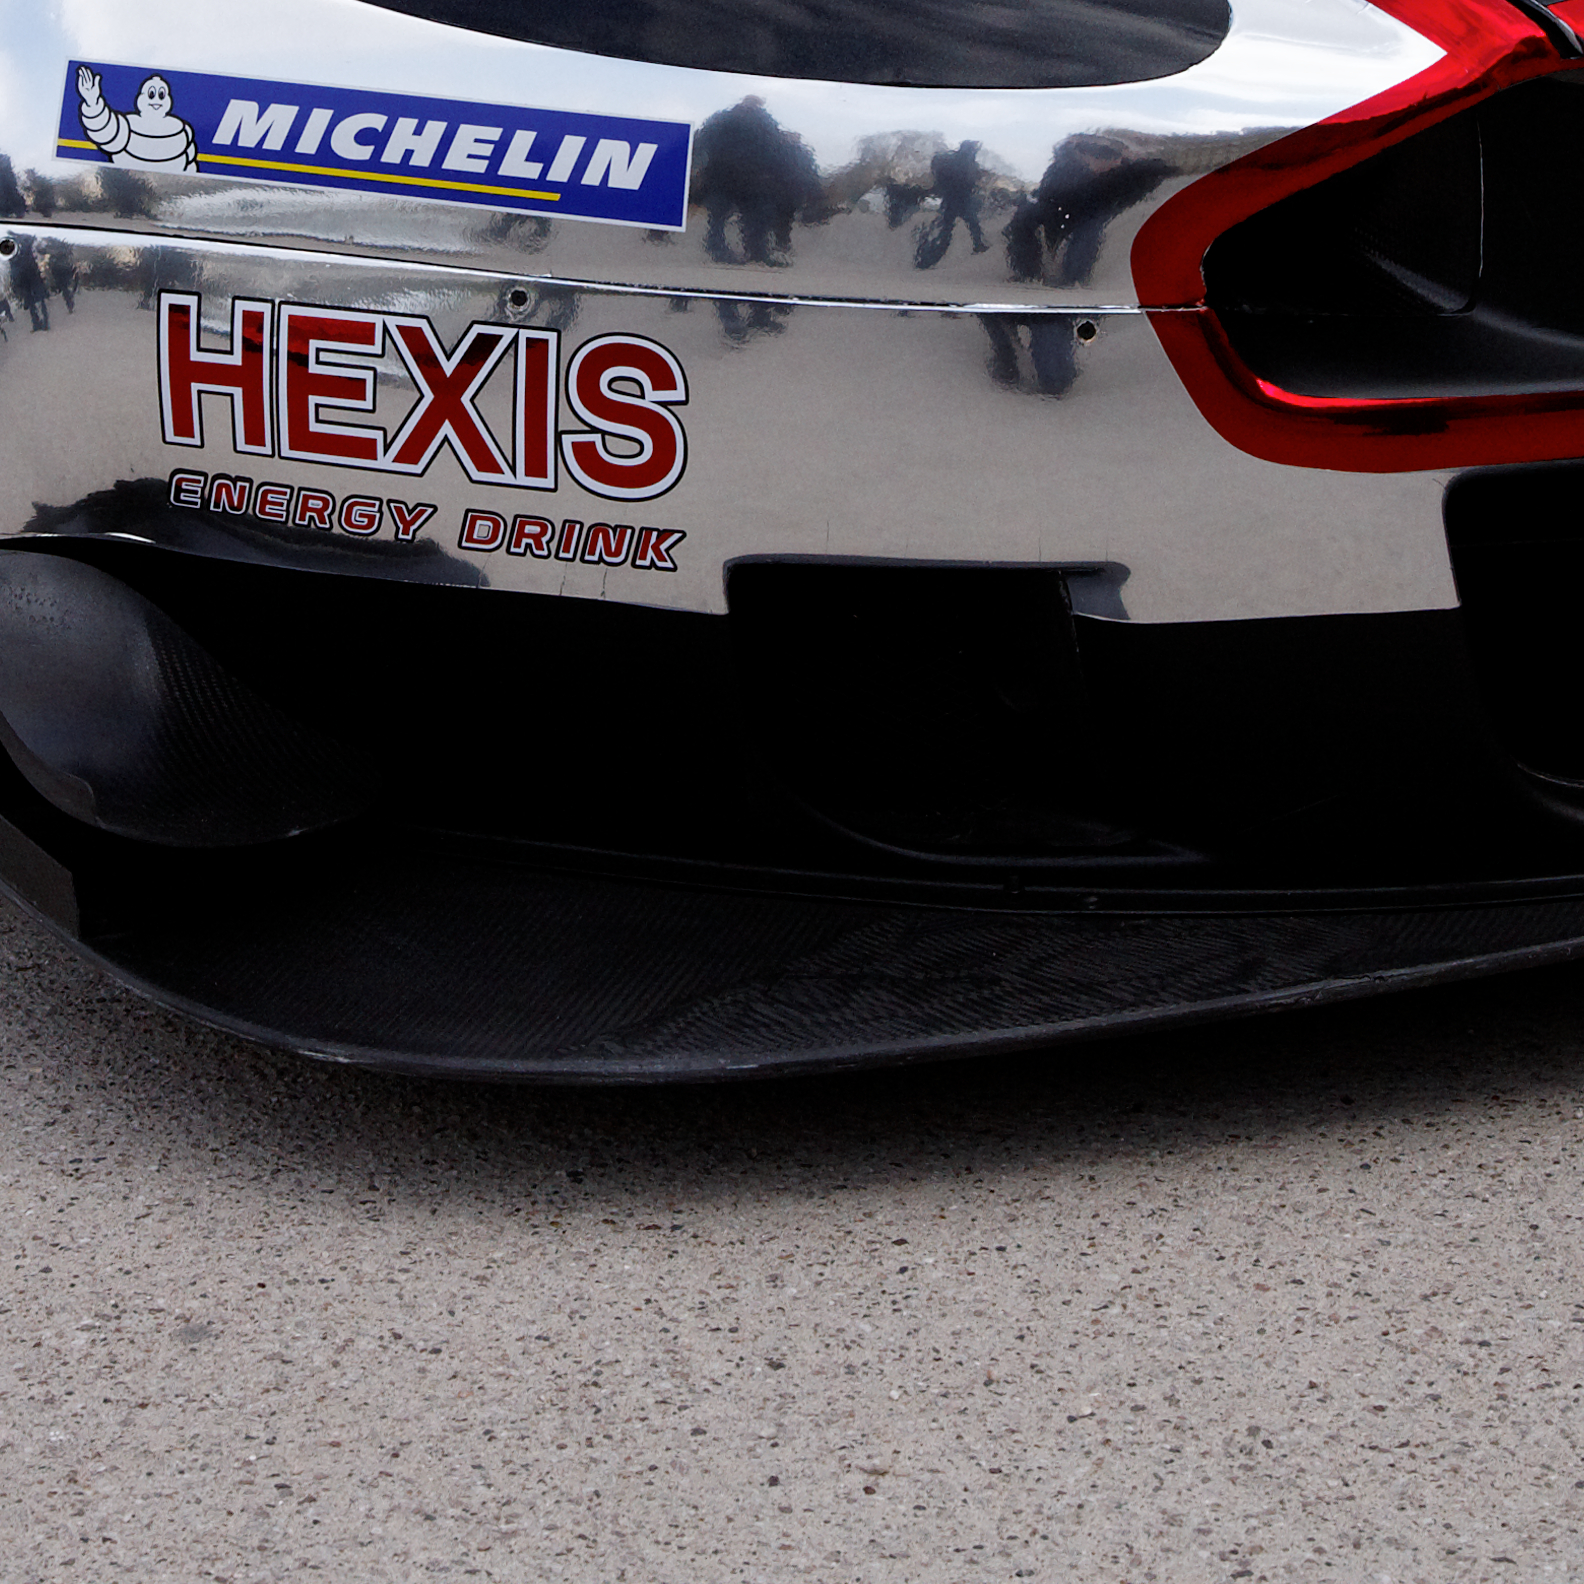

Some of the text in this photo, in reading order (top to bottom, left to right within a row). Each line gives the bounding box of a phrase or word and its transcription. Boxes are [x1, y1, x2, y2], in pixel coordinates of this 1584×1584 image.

[211, 98, 658, 191] MICHELIN
[157, 289, 689, 500] HEXIS
[167, 468, 687, 572] ENERGY DRINK
